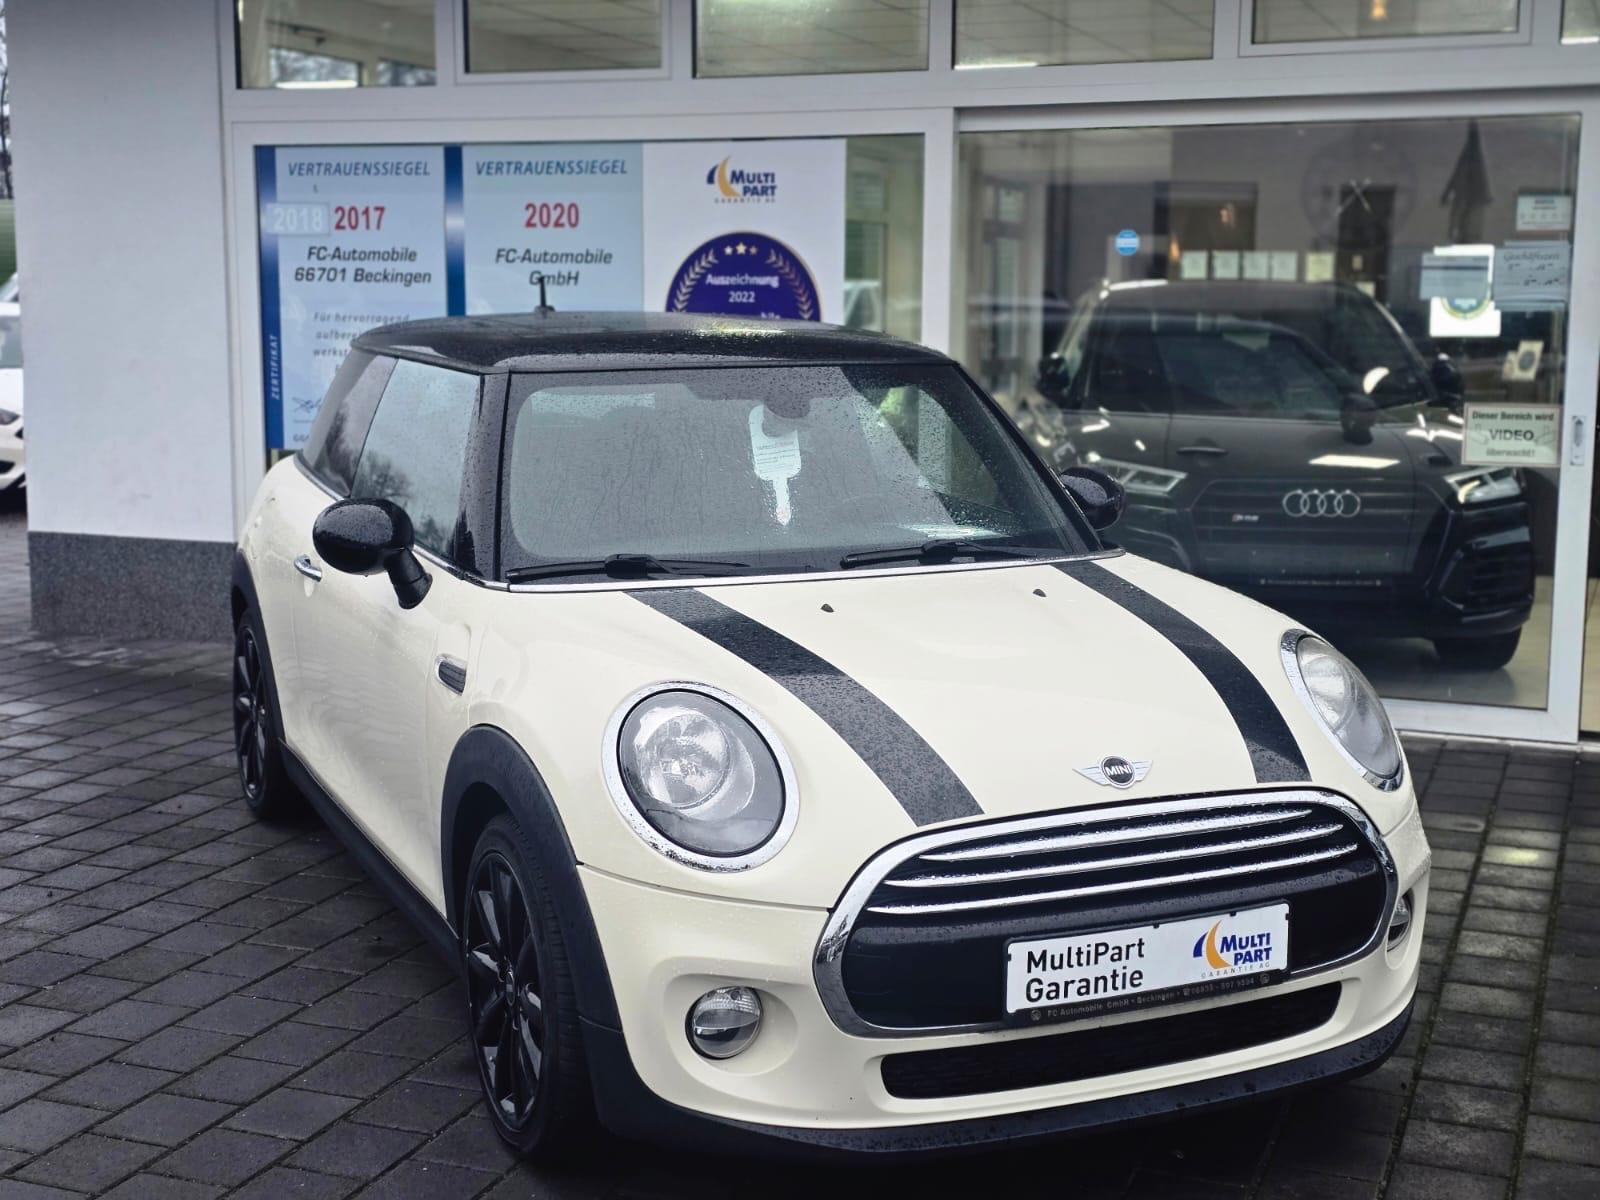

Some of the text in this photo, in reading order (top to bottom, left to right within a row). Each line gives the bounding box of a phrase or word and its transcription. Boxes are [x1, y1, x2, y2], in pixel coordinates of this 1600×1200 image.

[288, 161, 430, 177] VERTRAUENSSIEGEL
[475, 159, 628, 176] VERTRAUENSSIEGEL
[742, 185, 777, 197] PART
[273, 207, 323, 231] 2018
[334, 206, 385, 230] 2017
[524, 203, 579, 229] 2020
[307, 246, 417, 263] FC-Automobile
[495, 248, 612, 265] FC-Automobile
[294, 267, 431, 285] 66701 Beckingen
[528, 270, 579, 286] GmbH
[706, 273, 779, 288] Auszeichnung
[728, 291, 756, 303] 2022
[269, 335, 280, 400] ZERTIFIKAT
[1472, 411, 1554, 421] Dieser Bereich wird
[1489, 429, 1535, 441] VIDEO
[1105, 765, 1133, 776] MINI
[1220, 933, 1271, 953] MULTI
[1026, 938, 1145, 973] MultiPart
[1234, 947, 1272, 966] PART
[1201, 965, 1253, 979] GARANTIE
[1025, 968, 1144, 1003] Garantie
